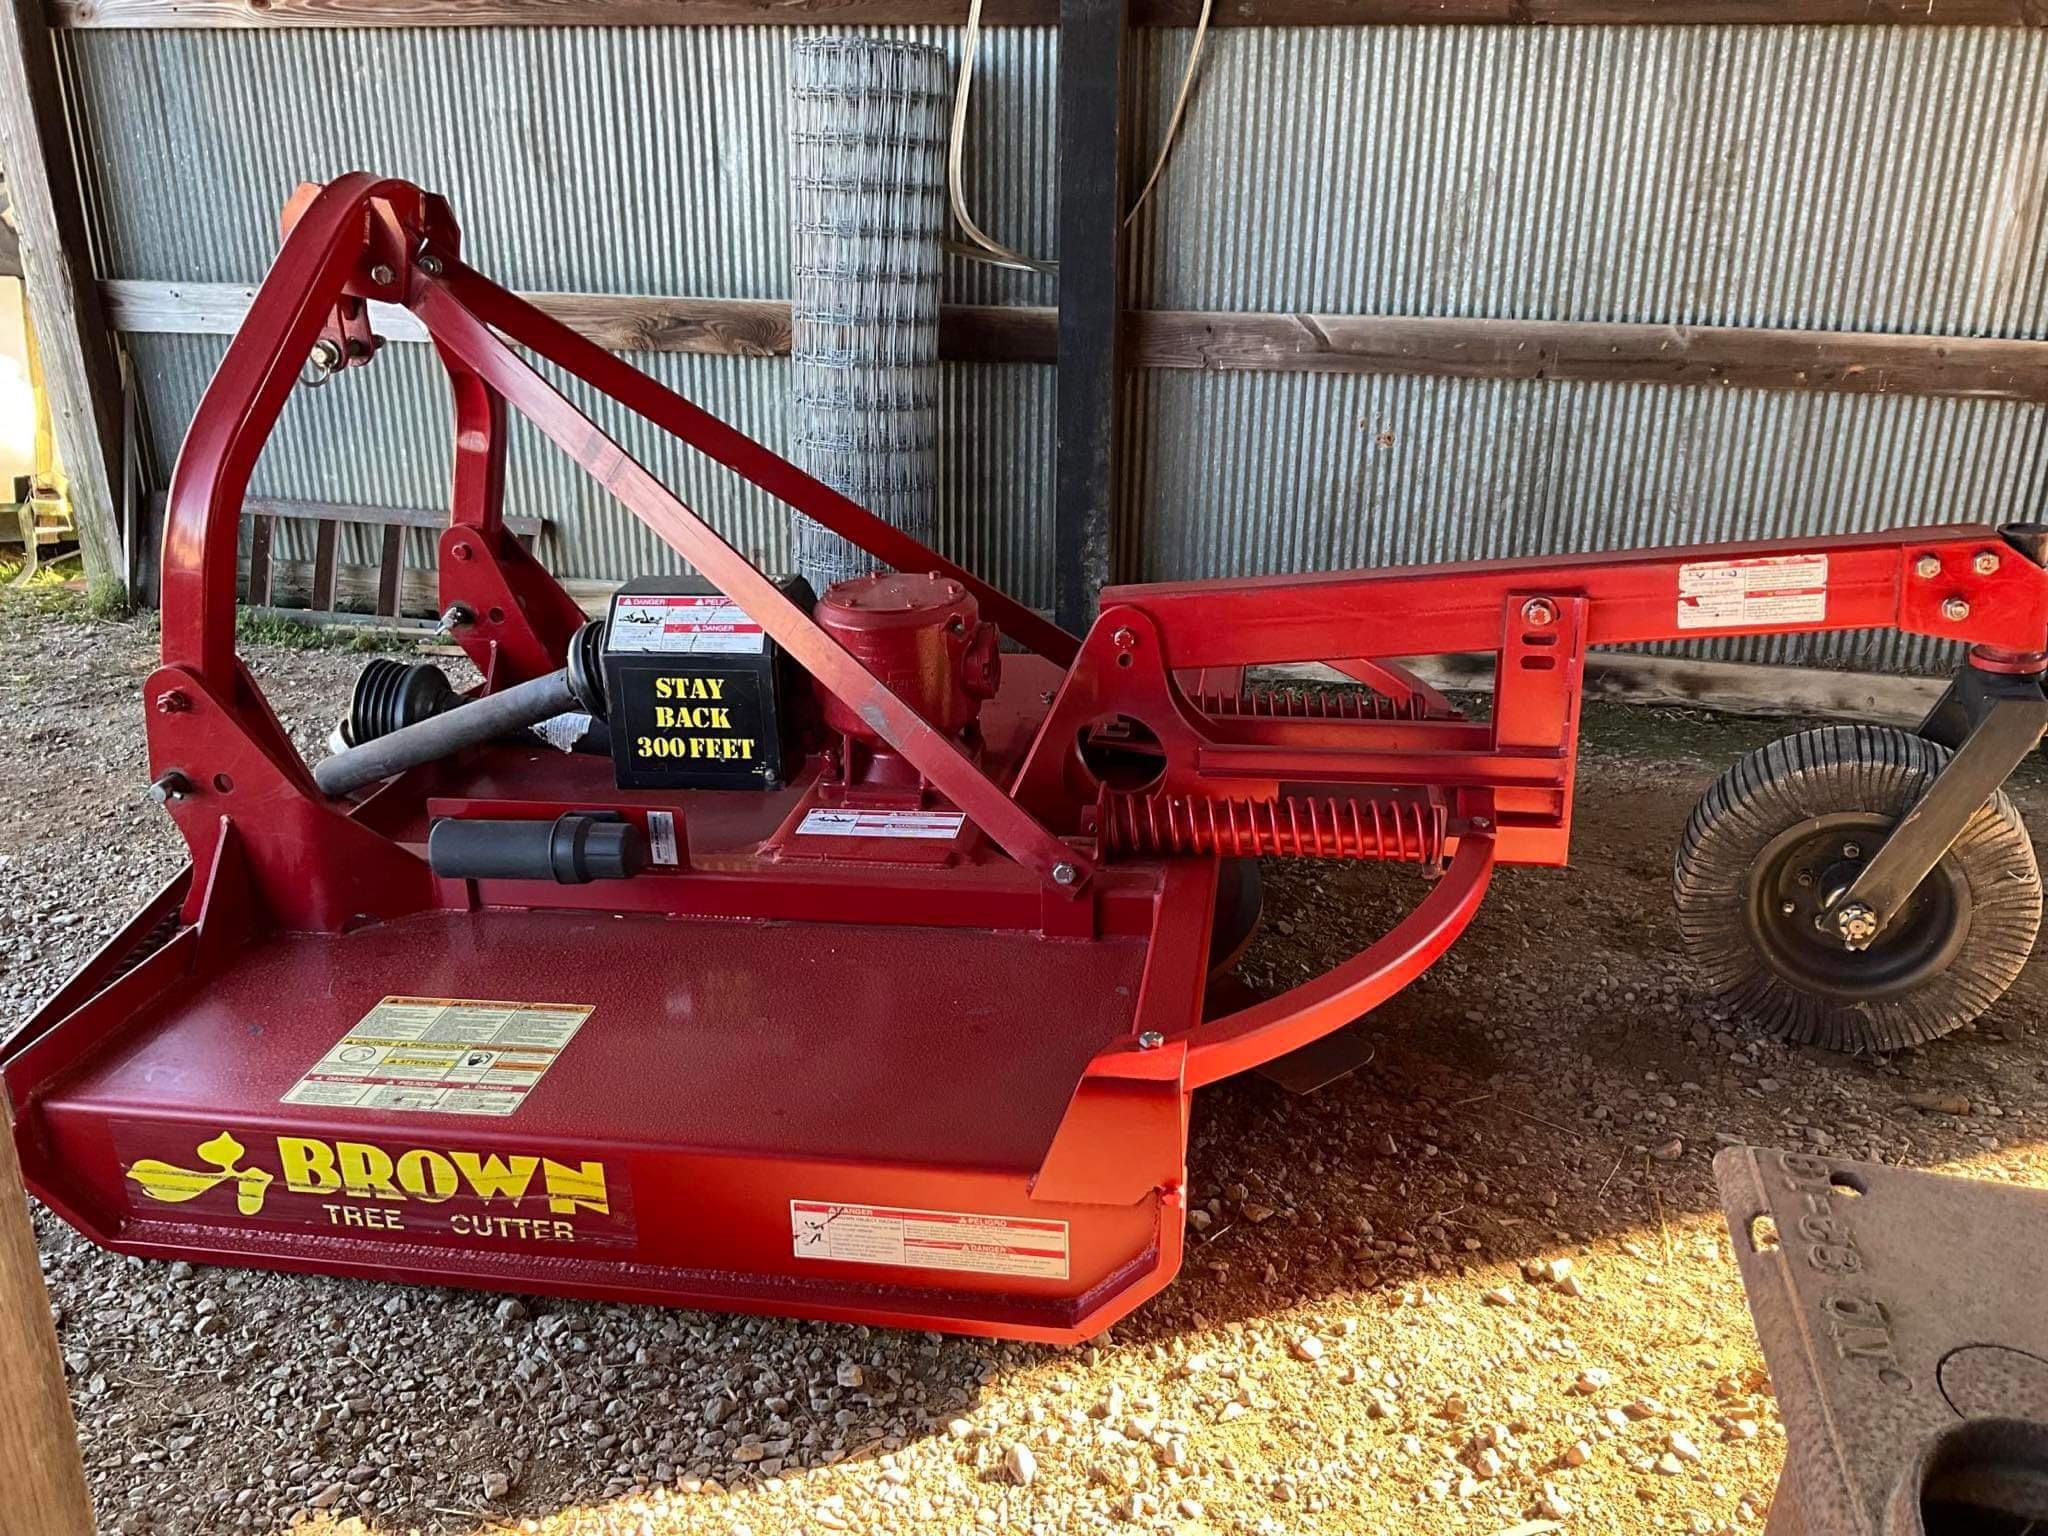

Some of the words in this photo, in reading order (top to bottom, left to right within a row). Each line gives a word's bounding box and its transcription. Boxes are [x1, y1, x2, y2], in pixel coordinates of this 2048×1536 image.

[633, 598, 666, 606] DANGER
[702, 624, 735, 632] DANGER
[655, 677, 725, 700] STAY
[654, 706, 732, 729] BACK
[637, 736, 686, 758] 300
[689, 737, 756, 760] FEET
[277, 1136, 610, 1215] BROWN
[322, 1204, 405, 1230] TREE
[450, 1213, 575, 1242] CUTTER
[968, 1217, 1008, 1228] PELIGRO
[970, 1243, 1008, 1254] DANGER
